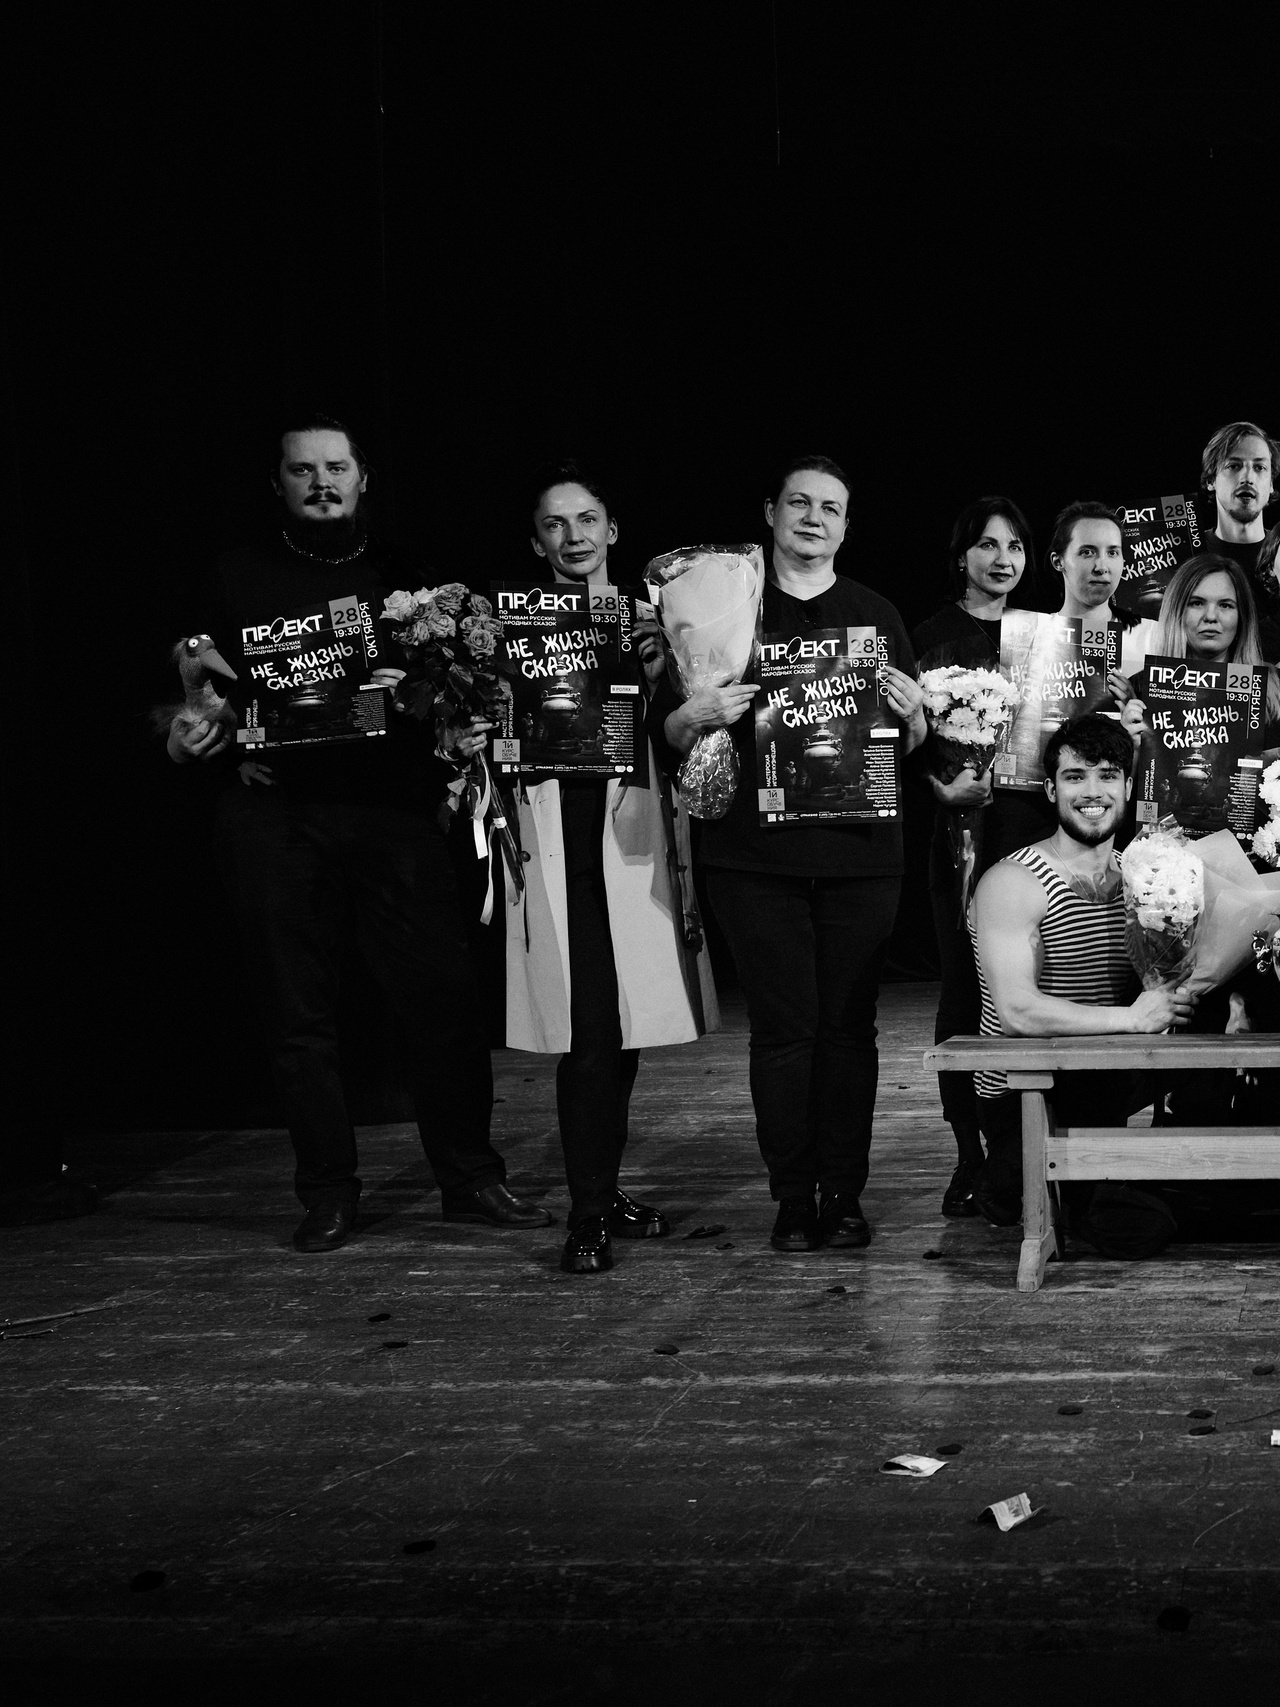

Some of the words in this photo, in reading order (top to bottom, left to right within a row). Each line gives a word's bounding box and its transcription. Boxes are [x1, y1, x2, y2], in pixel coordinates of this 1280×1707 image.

[1164, 504, 1185, 518] 28
[1165, 520, 1187, 529] 19:30
[1185, 500, 1202, 548] ОКТЯБРЯ
[497, 587, 582, 615] ПРОЕКТ
[591, 596, 617, 611] 28
[334, 608, 359, 625] 28
[590, 614, 617, 624] 19:30
[618, 595, 632, 652] ОКТЯБРЯ
[241, 614, 324, 644] ПРОЕКТ
[334, 625, 361, 639] 19:30
[359, 601, 379, 658] ОКТЯБРЯ
[1083, 630, 1105, 644] 28
[505, 637, 534, 660] НЕ
[760, 636, 840, 664] ПРОЕКТ
[850, 639, 875, 654] 28
[1081, 647, 1105, 658] 19:30
[250, 662, 279, 680] НЕ
[521, 650, 599, 680] СКАЗКА
[849, 658, 875, 668] 19:30
[266, 662, 347, 691] СКАЗКА
[1149, 663, 1221, 690] ПРОЕКТ
[1228, 674, 1250, 689] 28
[767, 687, 794, 710] НЕ
[1225, 692, 1249, 703] 19:30
[1249, 674, 1262, 730] ОКТЯБРЯ
[782, 695, 859, 729] СКАЗКА
[1151, 710, 1175, 730] НЕ
[1162, 726, 1229, 750] СКАЗКА
